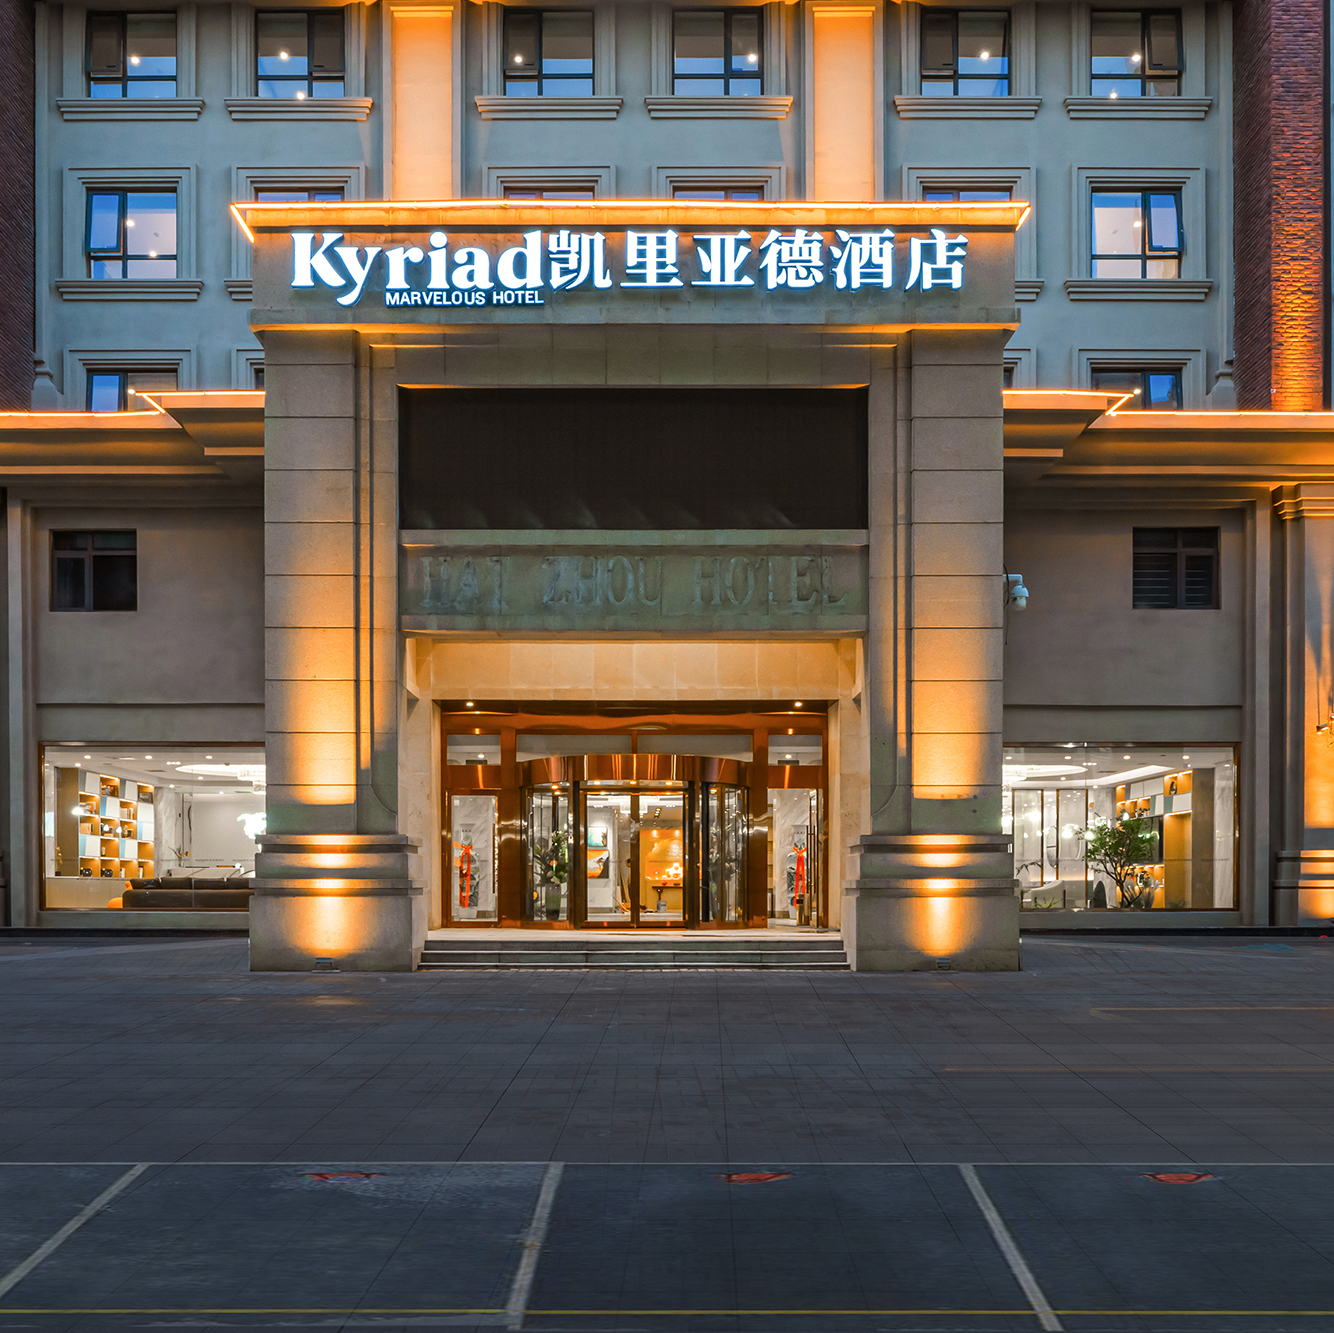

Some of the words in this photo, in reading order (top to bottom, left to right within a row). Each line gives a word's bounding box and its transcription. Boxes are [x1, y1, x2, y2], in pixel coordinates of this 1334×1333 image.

[291, 229, 545, 307] Kyriad
[547, 228, 970, 292] 凯里亚德酒店
[385, 290, 487, 306] MARVELOUS
[492, 289, 545, 305] HOTEL
